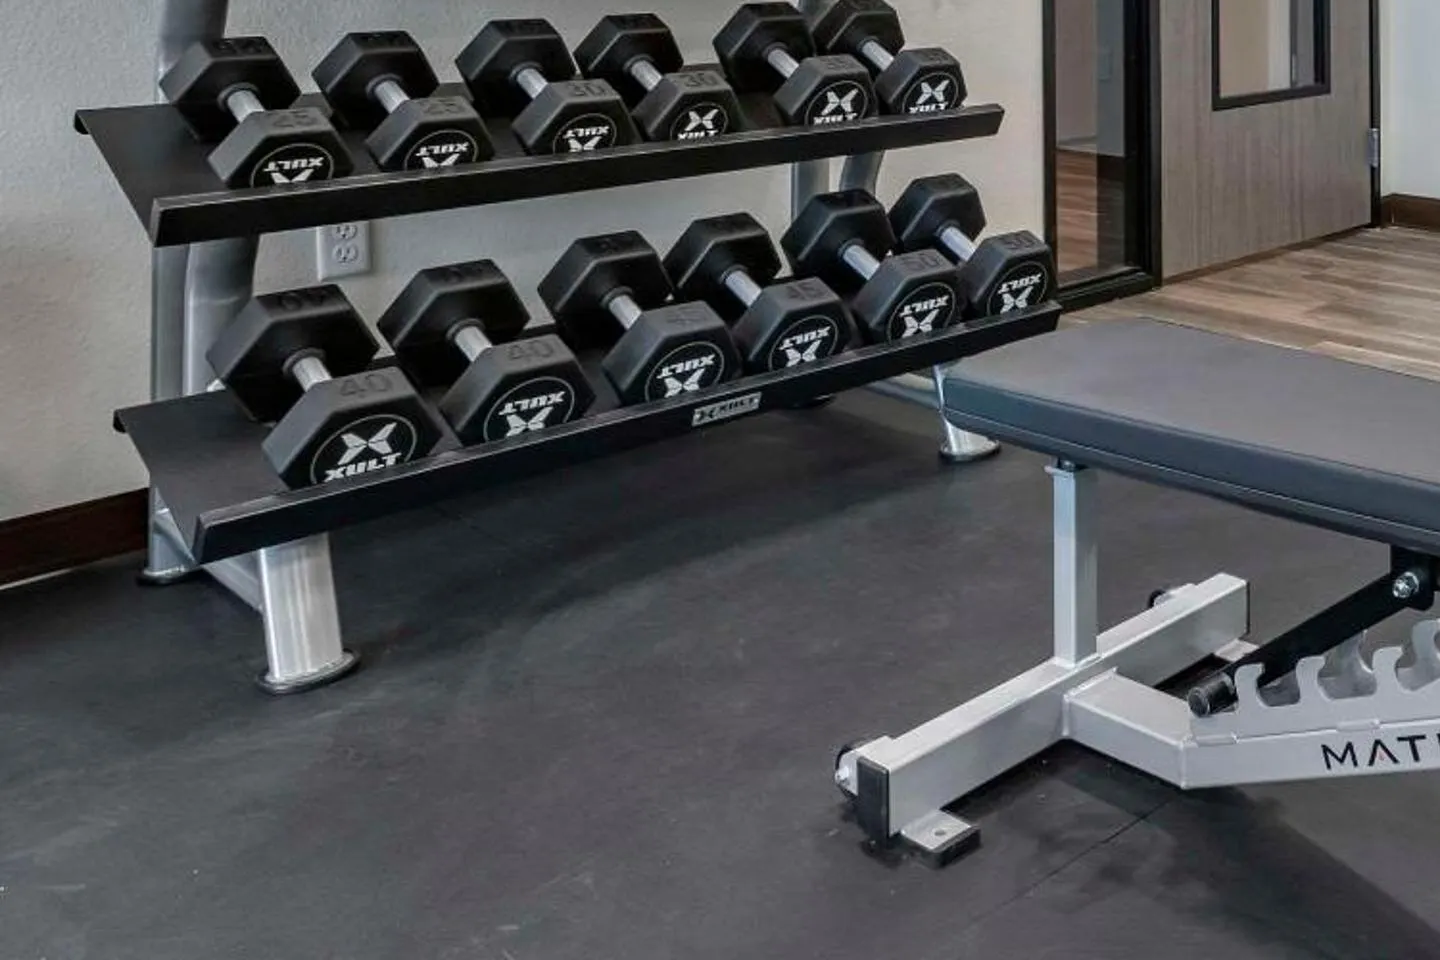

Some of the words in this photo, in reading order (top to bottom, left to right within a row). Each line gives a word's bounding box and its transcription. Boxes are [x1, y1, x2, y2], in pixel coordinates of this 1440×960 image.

[562, 124, 611, 139] XULT
[416, 142, 469, 157] XULT
[264, 155, 324, 172] XULT
[998, 273, 1042, 294] XULT
[900, 295, 949, 318] XULT
[780, 325, 830, 349] XULT
[656, 353, 716, 379] XULT
[498, 390, 566, 416] XULT
[324, 451, 401, 483] XULT
